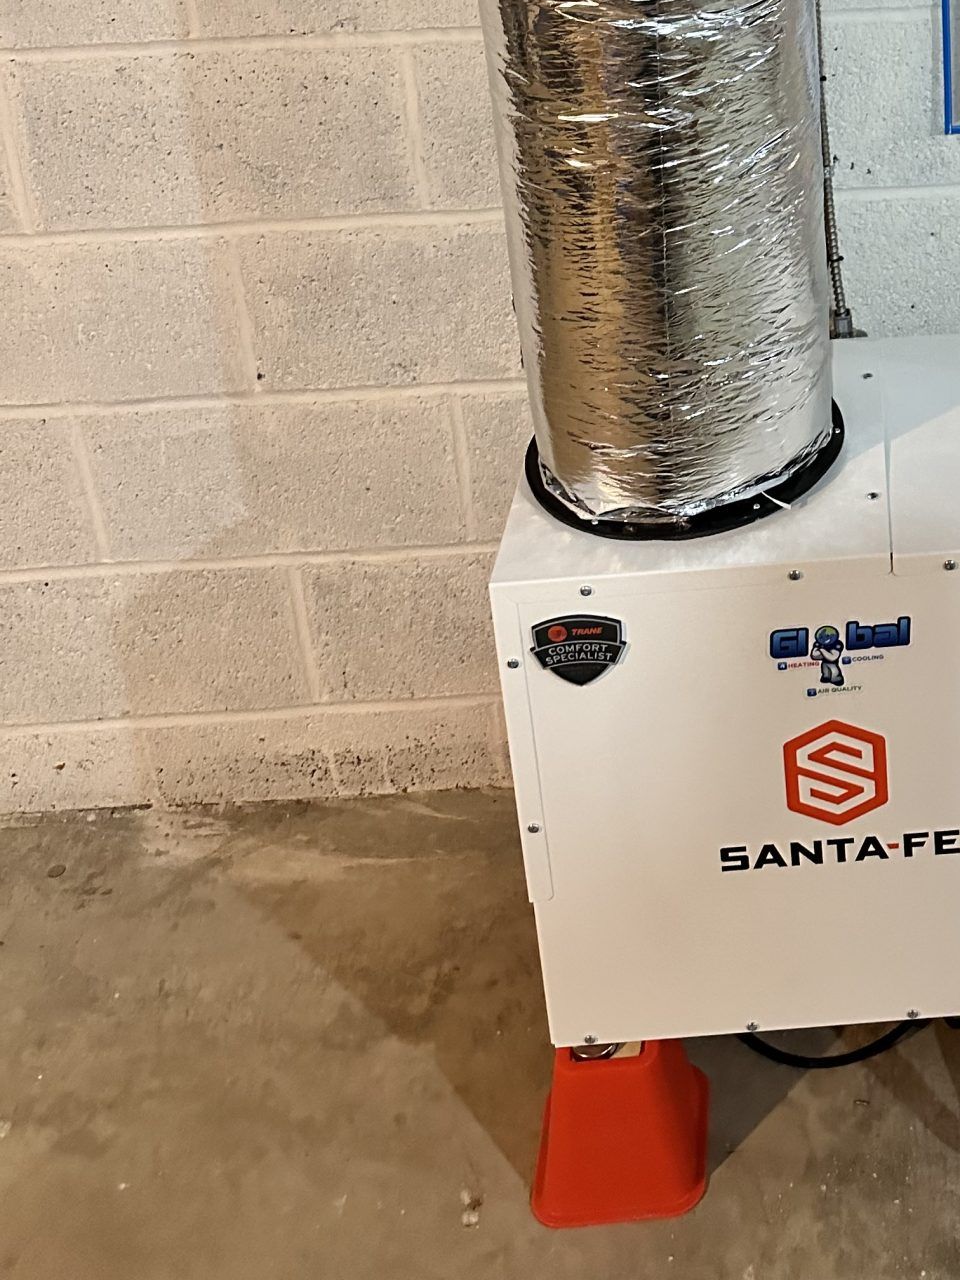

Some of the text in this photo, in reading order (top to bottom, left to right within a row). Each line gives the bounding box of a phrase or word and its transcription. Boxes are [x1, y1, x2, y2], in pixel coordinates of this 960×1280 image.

[571, 627, 604, 636] TRANE
[548, 644, 608, 656] COMFORT
[545, 652, 613, 665] SPECIALIST
[831, 685, 862, 693] QUALITY
[719, 829, 960, 873] SANTA-FE
